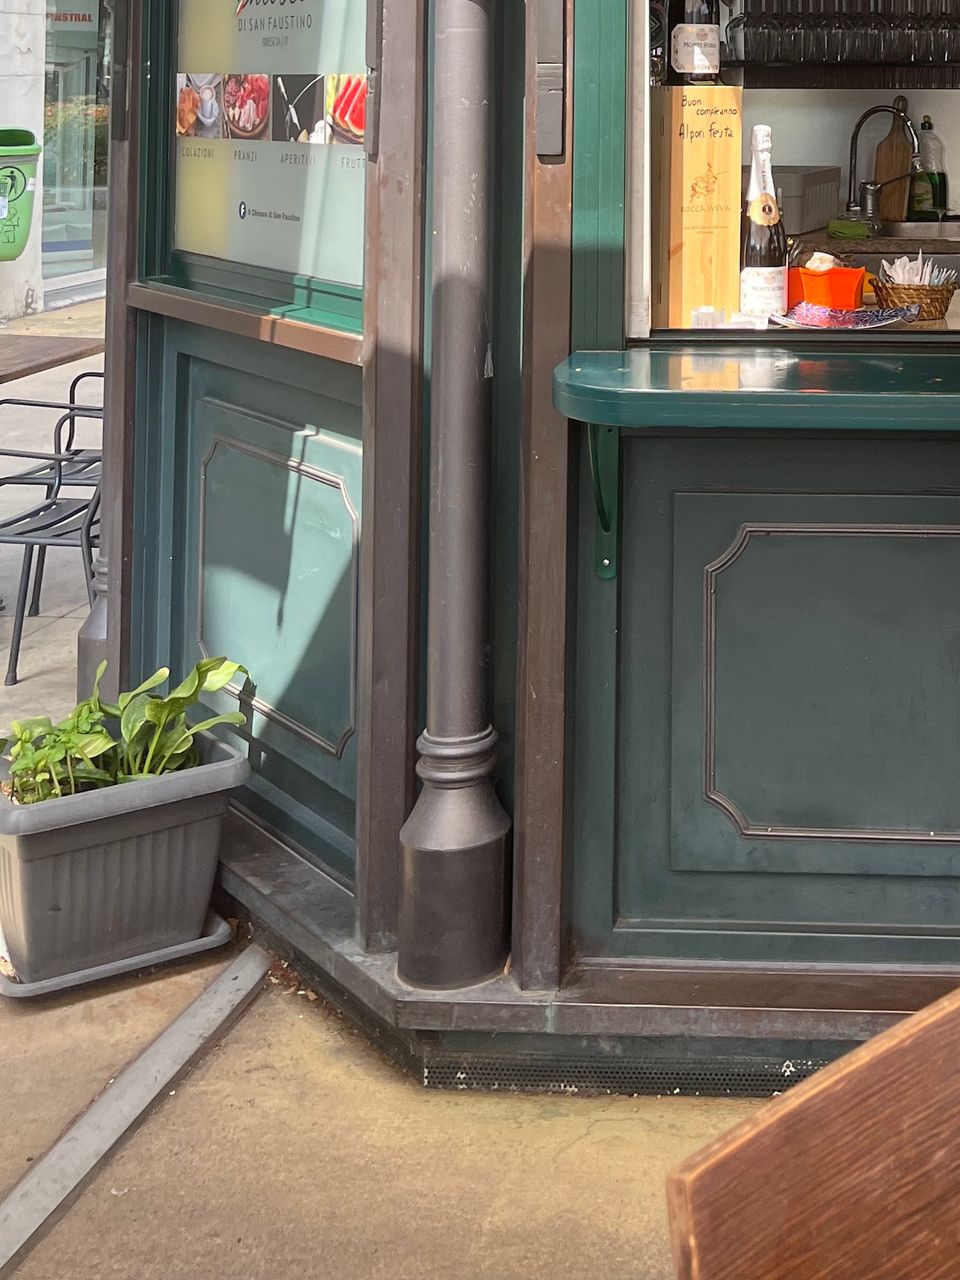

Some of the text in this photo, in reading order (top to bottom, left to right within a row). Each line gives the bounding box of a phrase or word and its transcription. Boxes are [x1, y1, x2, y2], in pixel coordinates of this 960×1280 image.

[249, 17, 265, 31] SAN
[268, 14, 313, 30] FAUSTINO
[681, 95, 702, 107] Buon
[181, 146, 215, 159] COLAZIONI
[233, 150, 257, 162] PRANZI
[280, 154, 316, 166] APERITIVI
